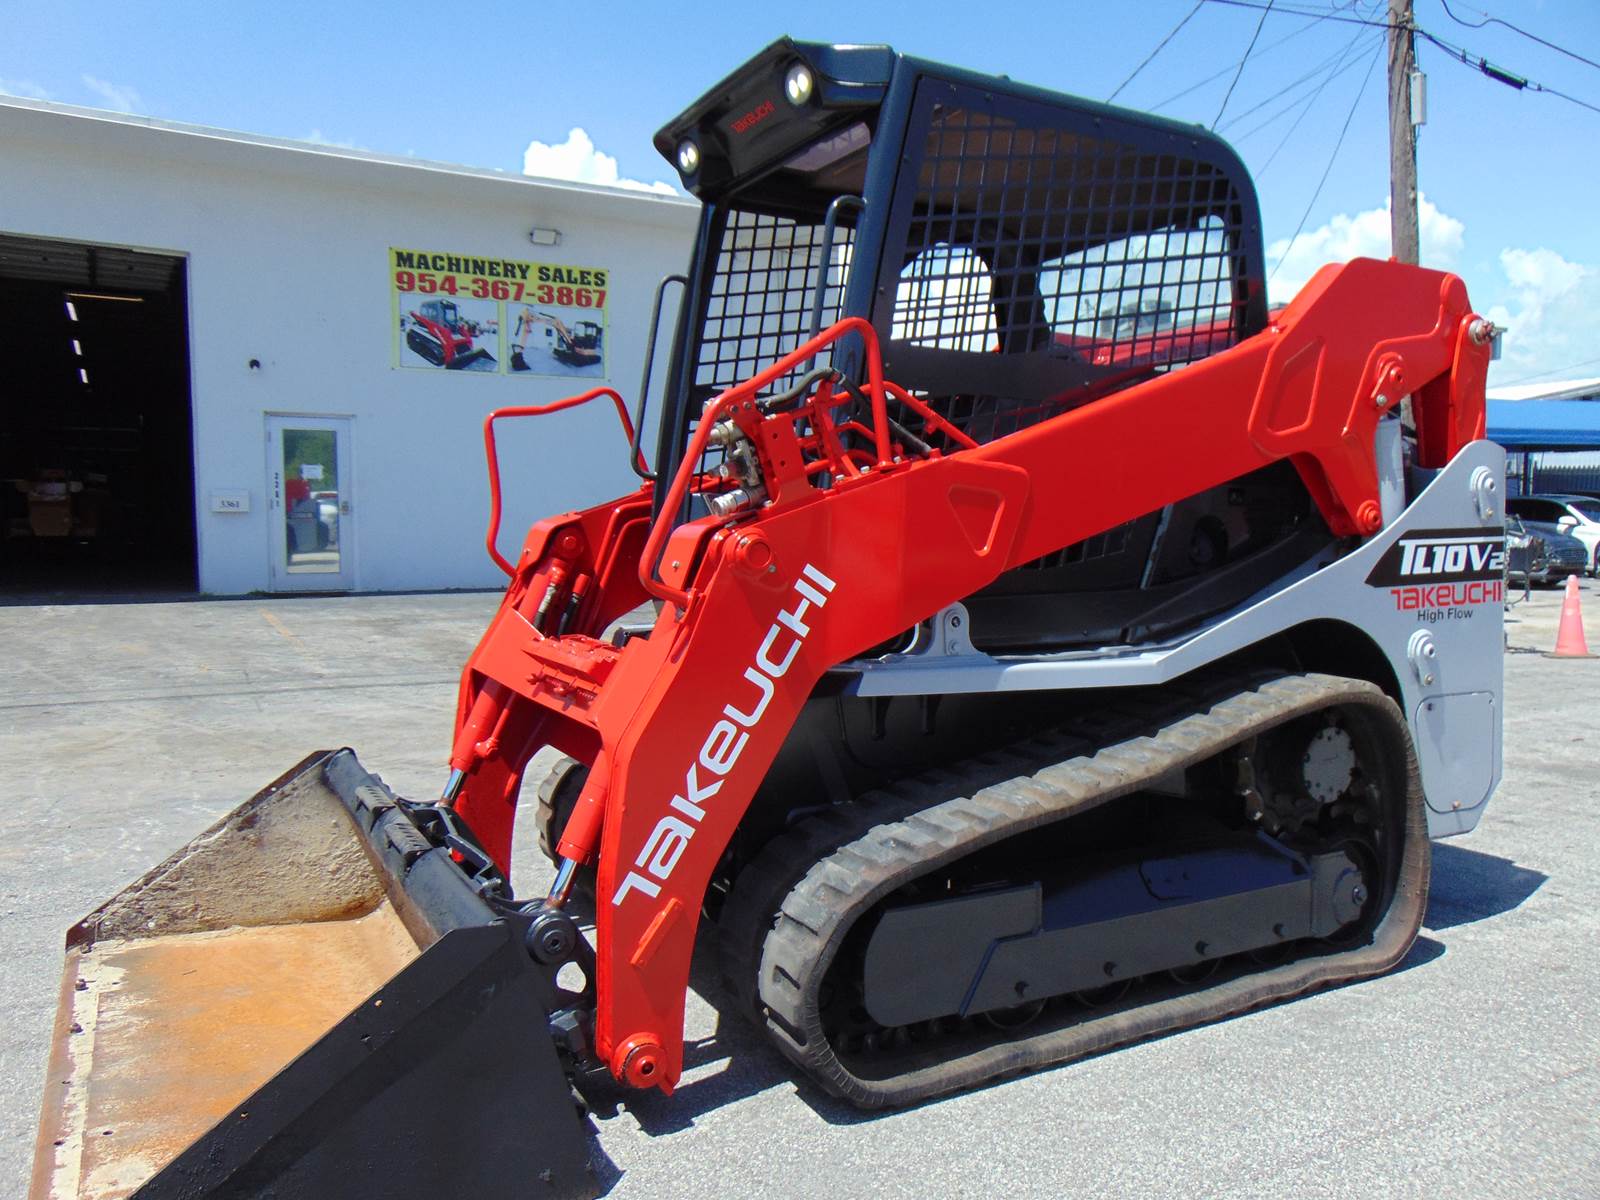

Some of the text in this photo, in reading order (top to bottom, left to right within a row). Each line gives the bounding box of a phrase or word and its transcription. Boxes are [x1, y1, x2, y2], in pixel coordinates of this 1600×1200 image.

[395, 251, 606, 287] MACHINERY SALES
[395, 271, 606, 308] 954-367-3867
[1399, 540, 1505, 576] TL10V2
[1390, 581, 1502, 611] TAKEUCHI
[1417, 607, 1474, 624] High Flow
[611, 563, 837, 906] TAKEUCHI
